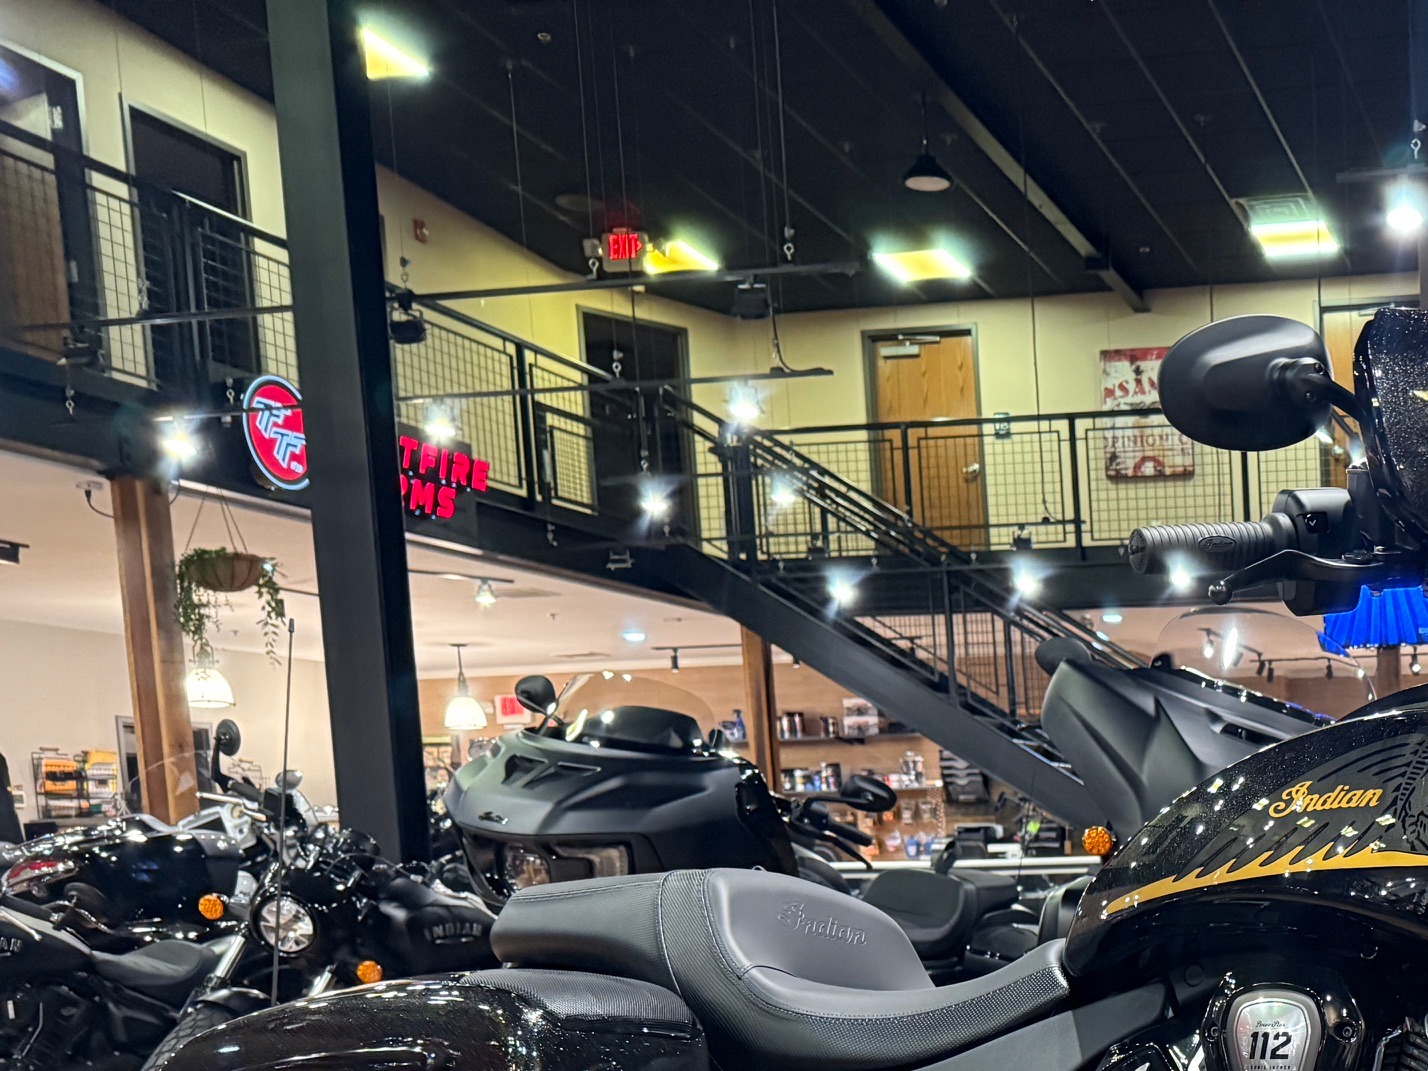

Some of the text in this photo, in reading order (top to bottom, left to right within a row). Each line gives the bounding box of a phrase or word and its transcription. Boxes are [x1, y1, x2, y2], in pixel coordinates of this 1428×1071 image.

[609, 234, 638, 260] EXIT
[1268, 781, 1384, 818] Indian
[778, 901, 867, 946] Indian
[1249, 1031, 1292, 1060] 112
